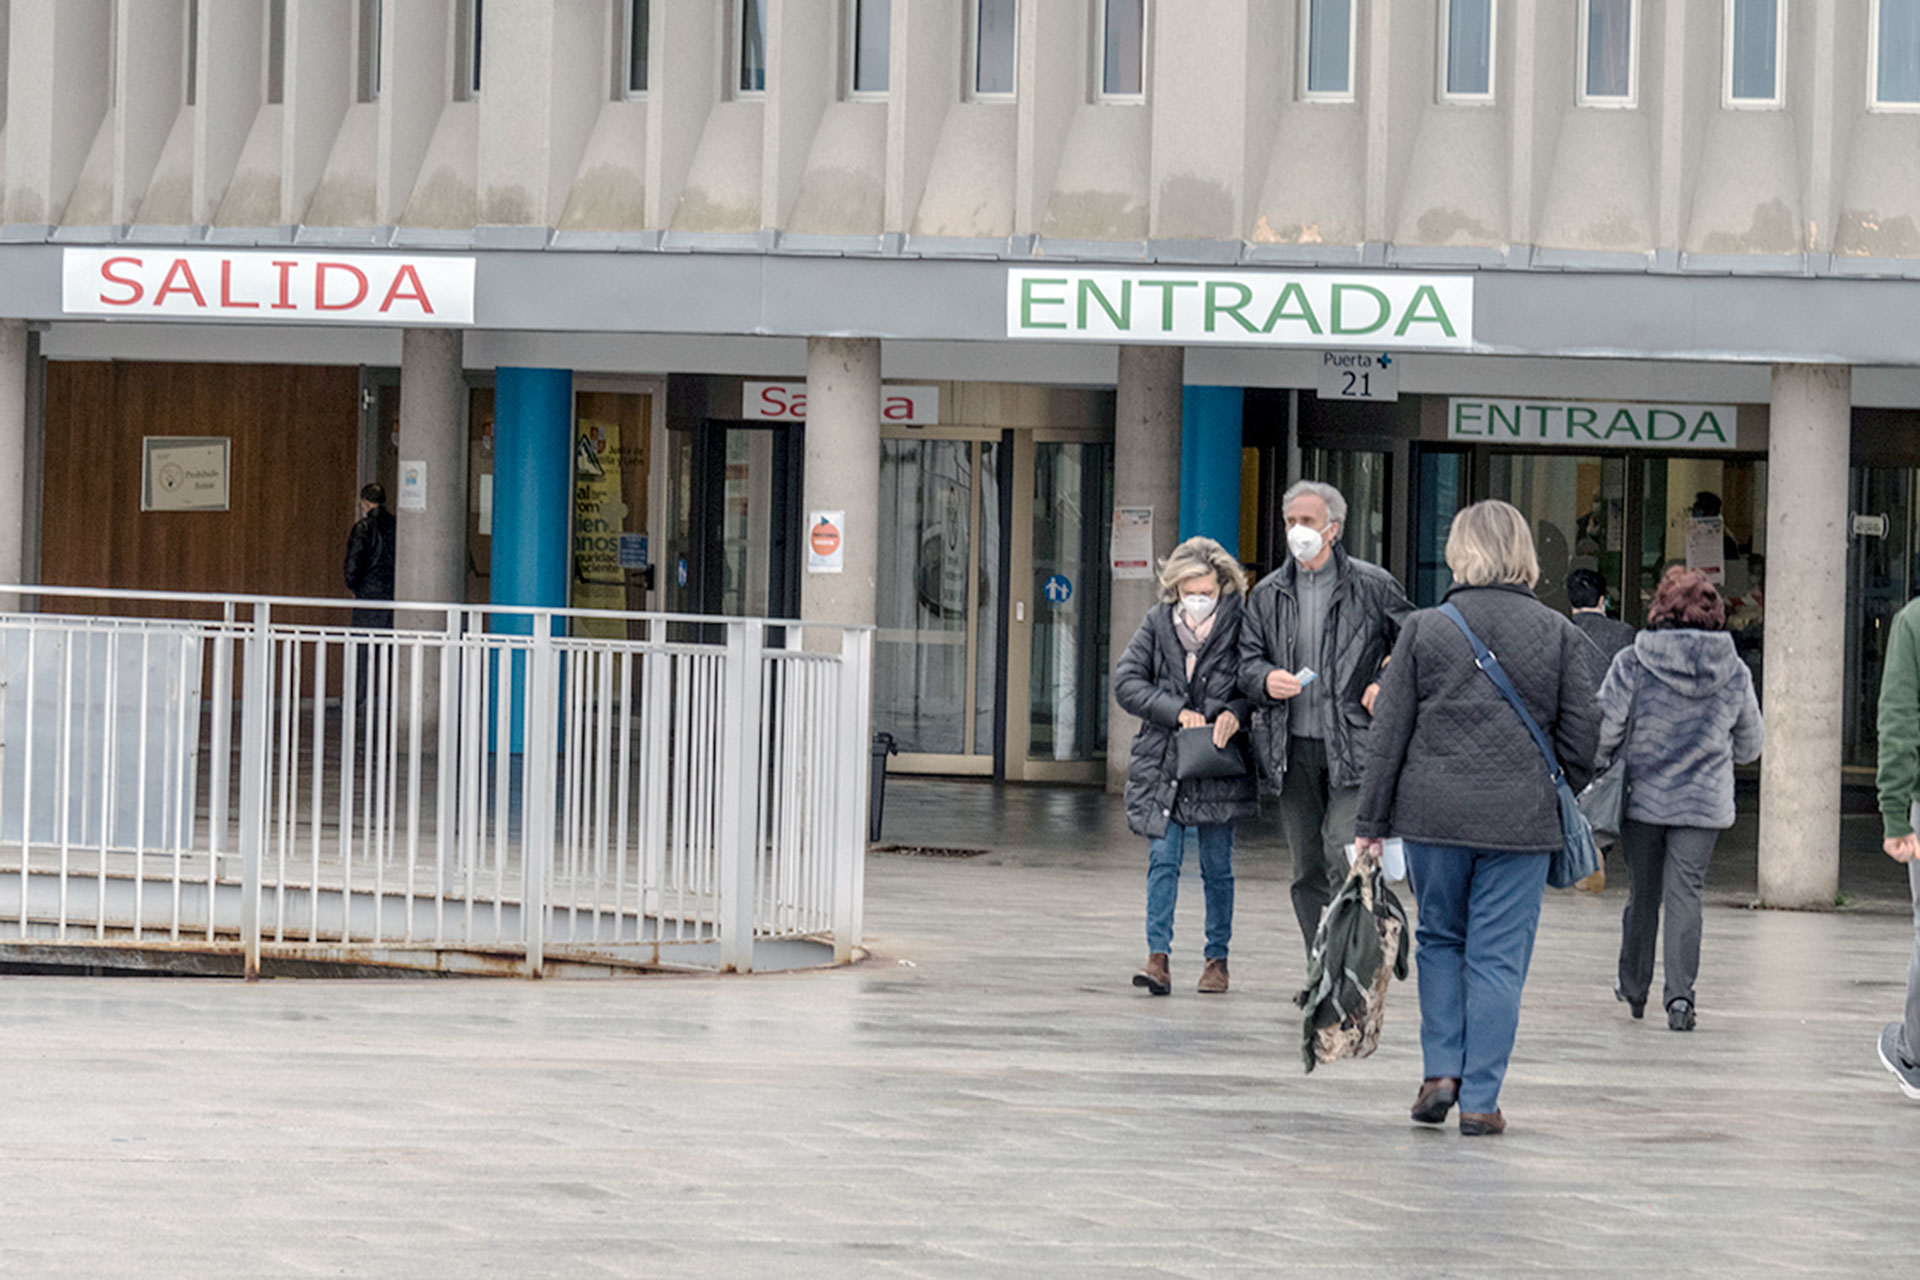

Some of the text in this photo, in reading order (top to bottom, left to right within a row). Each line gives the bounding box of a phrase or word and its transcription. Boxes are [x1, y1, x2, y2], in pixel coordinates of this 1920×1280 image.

[99, 256, 435, 314] SALIDA
[1020, 278, 1457, 338] ENTRADA
[1323, 351, 1372, 367] Puerta
[1341, 370, 1372, 397] 21
[760, 386, 914, 420] Saa
[1455, 403, 1728, 443] ENTRADA
